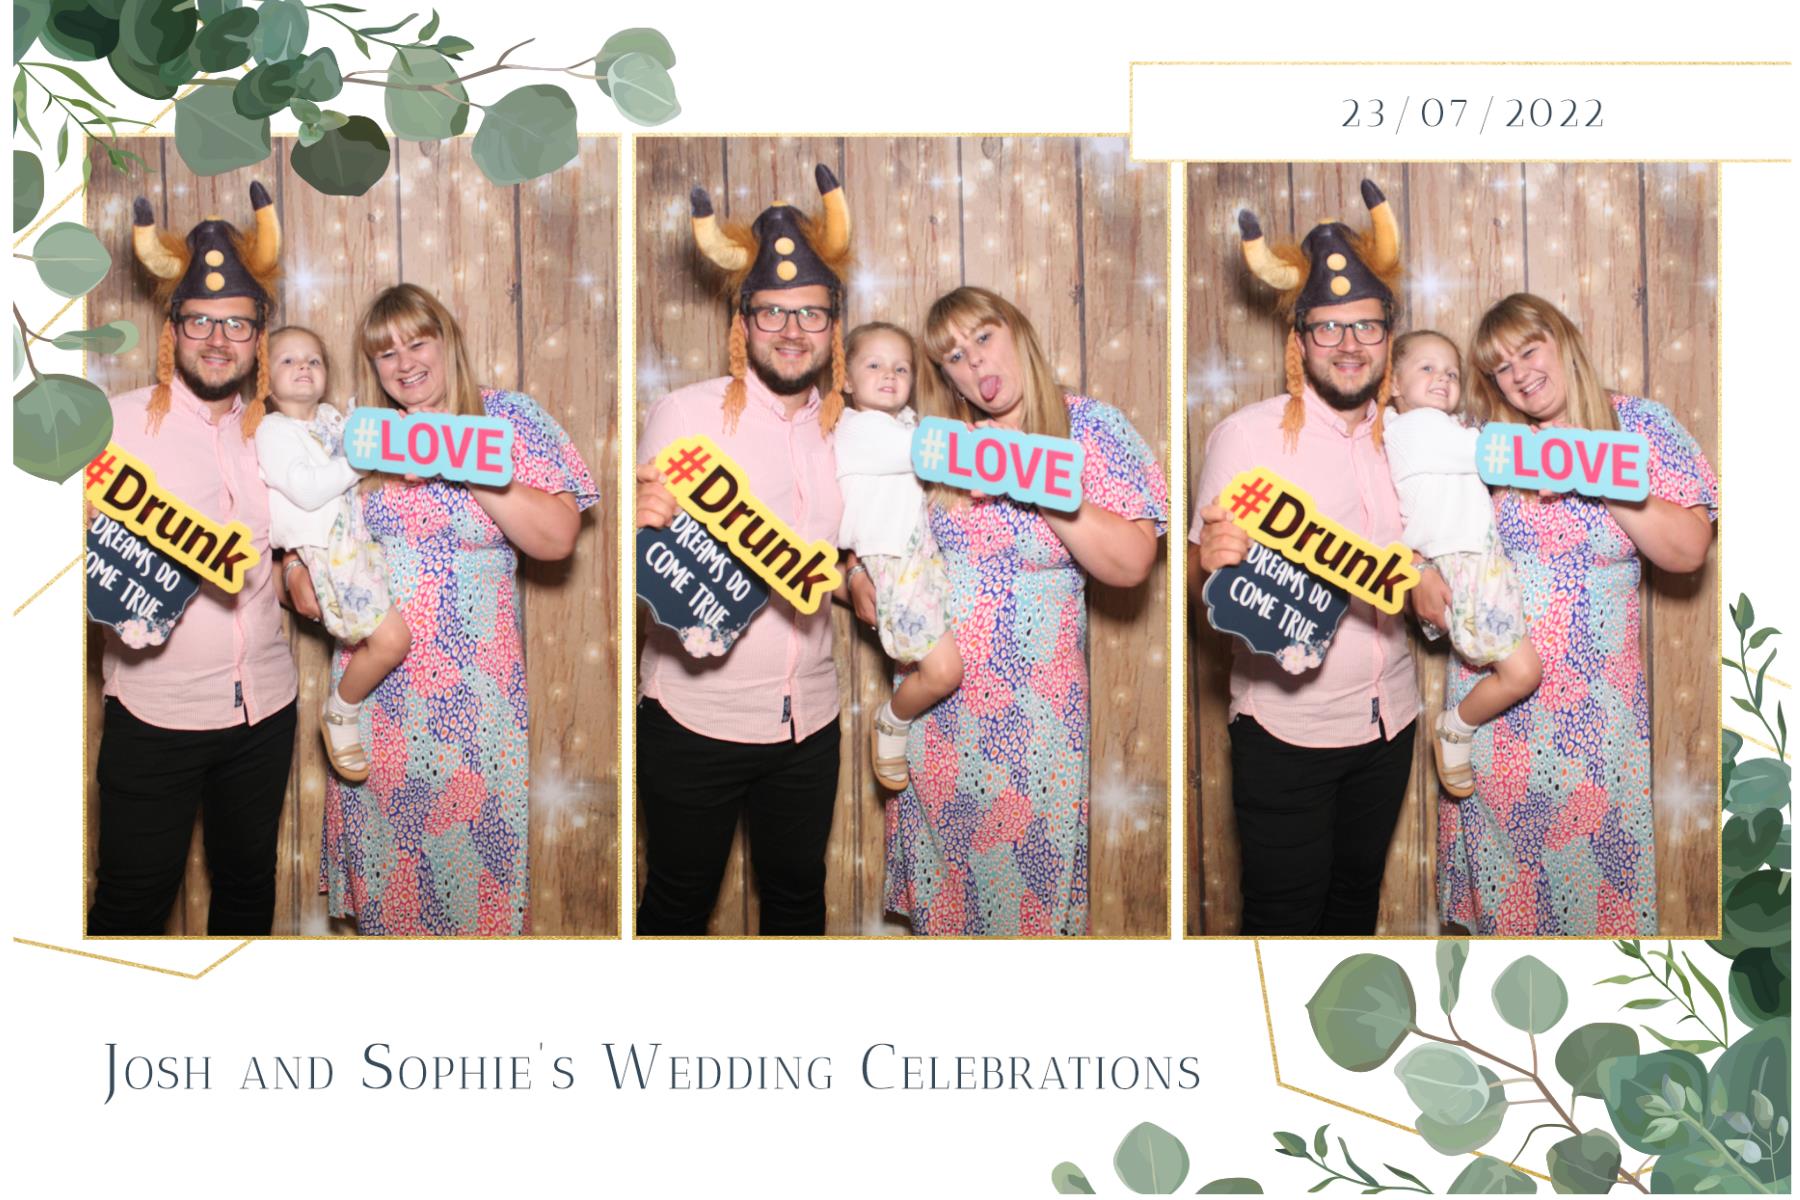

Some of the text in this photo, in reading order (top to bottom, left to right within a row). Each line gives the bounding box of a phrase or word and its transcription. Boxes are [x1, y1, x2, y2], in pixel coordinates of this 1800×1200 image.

[352, 417, 504, 473] #LOVE
[919, 428, 1074, 498] #LOVE
[1483, 433, 1639, 488] #LOVE
[86, 450, 249, 583] #Drunk
[91, 513, 181, 592] DREAMS DO
[664, 446, 830, 603] #Drunk
[1230, 477, 1408, 604] #Drunk
[86, 546, 164, 621] OME TRUE
[645, 541, 731, 630] COME TRUE
[671, 511, 751, 602] DREAMS DO
[1246, 543, 1332, 613] DREAMS DO
[1229, 575, 1319, 644] COME TRUE
